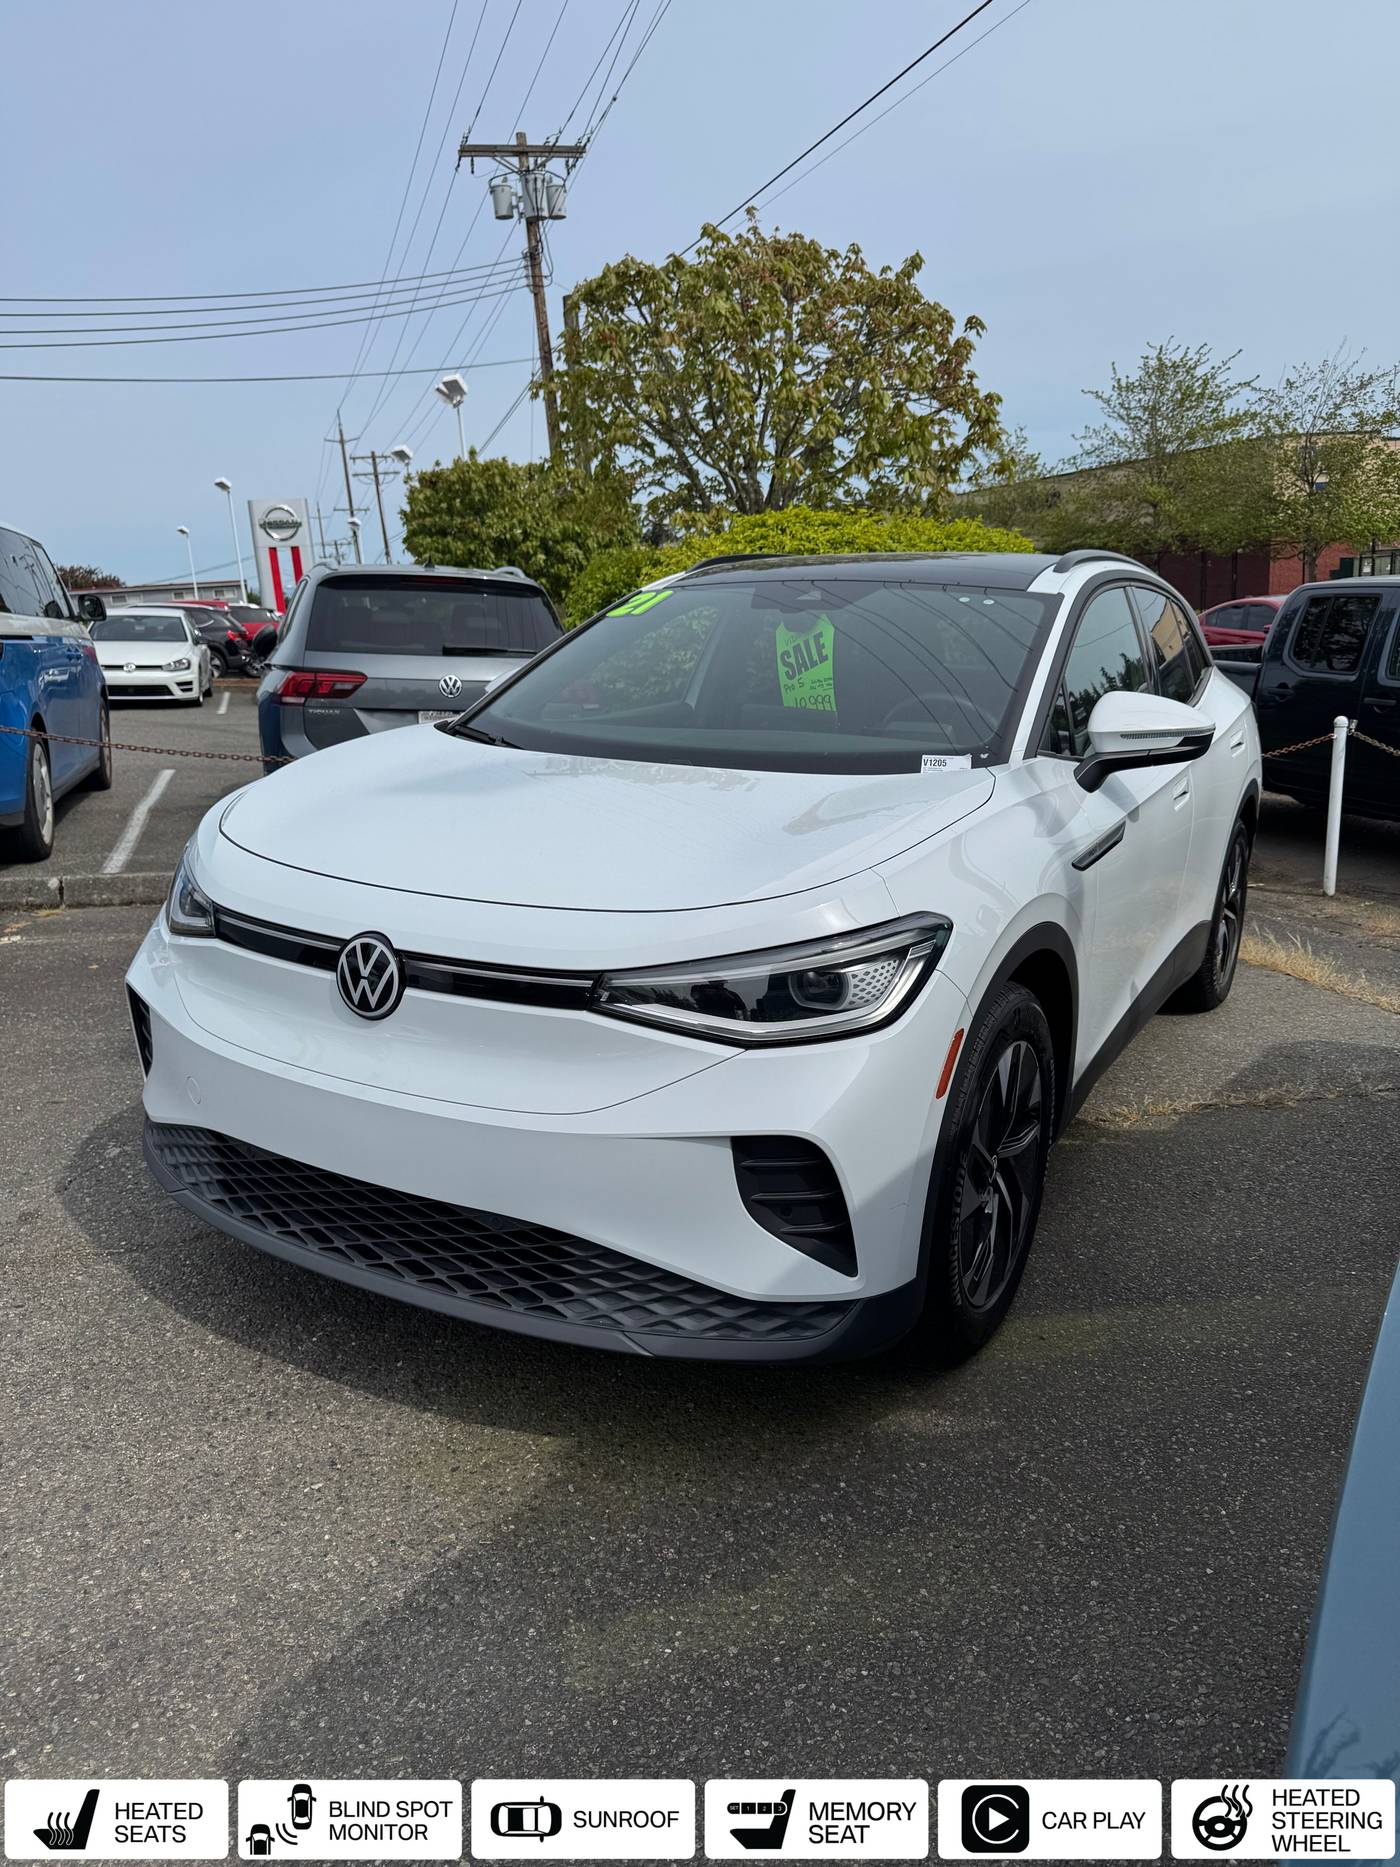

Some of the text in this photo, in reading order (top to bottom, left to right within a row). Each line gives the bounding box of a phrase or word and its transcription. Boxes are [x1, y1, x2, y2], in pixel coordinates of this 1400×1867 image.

[780, 631, 829, 681] SALE
[923, 758, 947, 767] V1205
[340, 941, 396, 1011] VW
